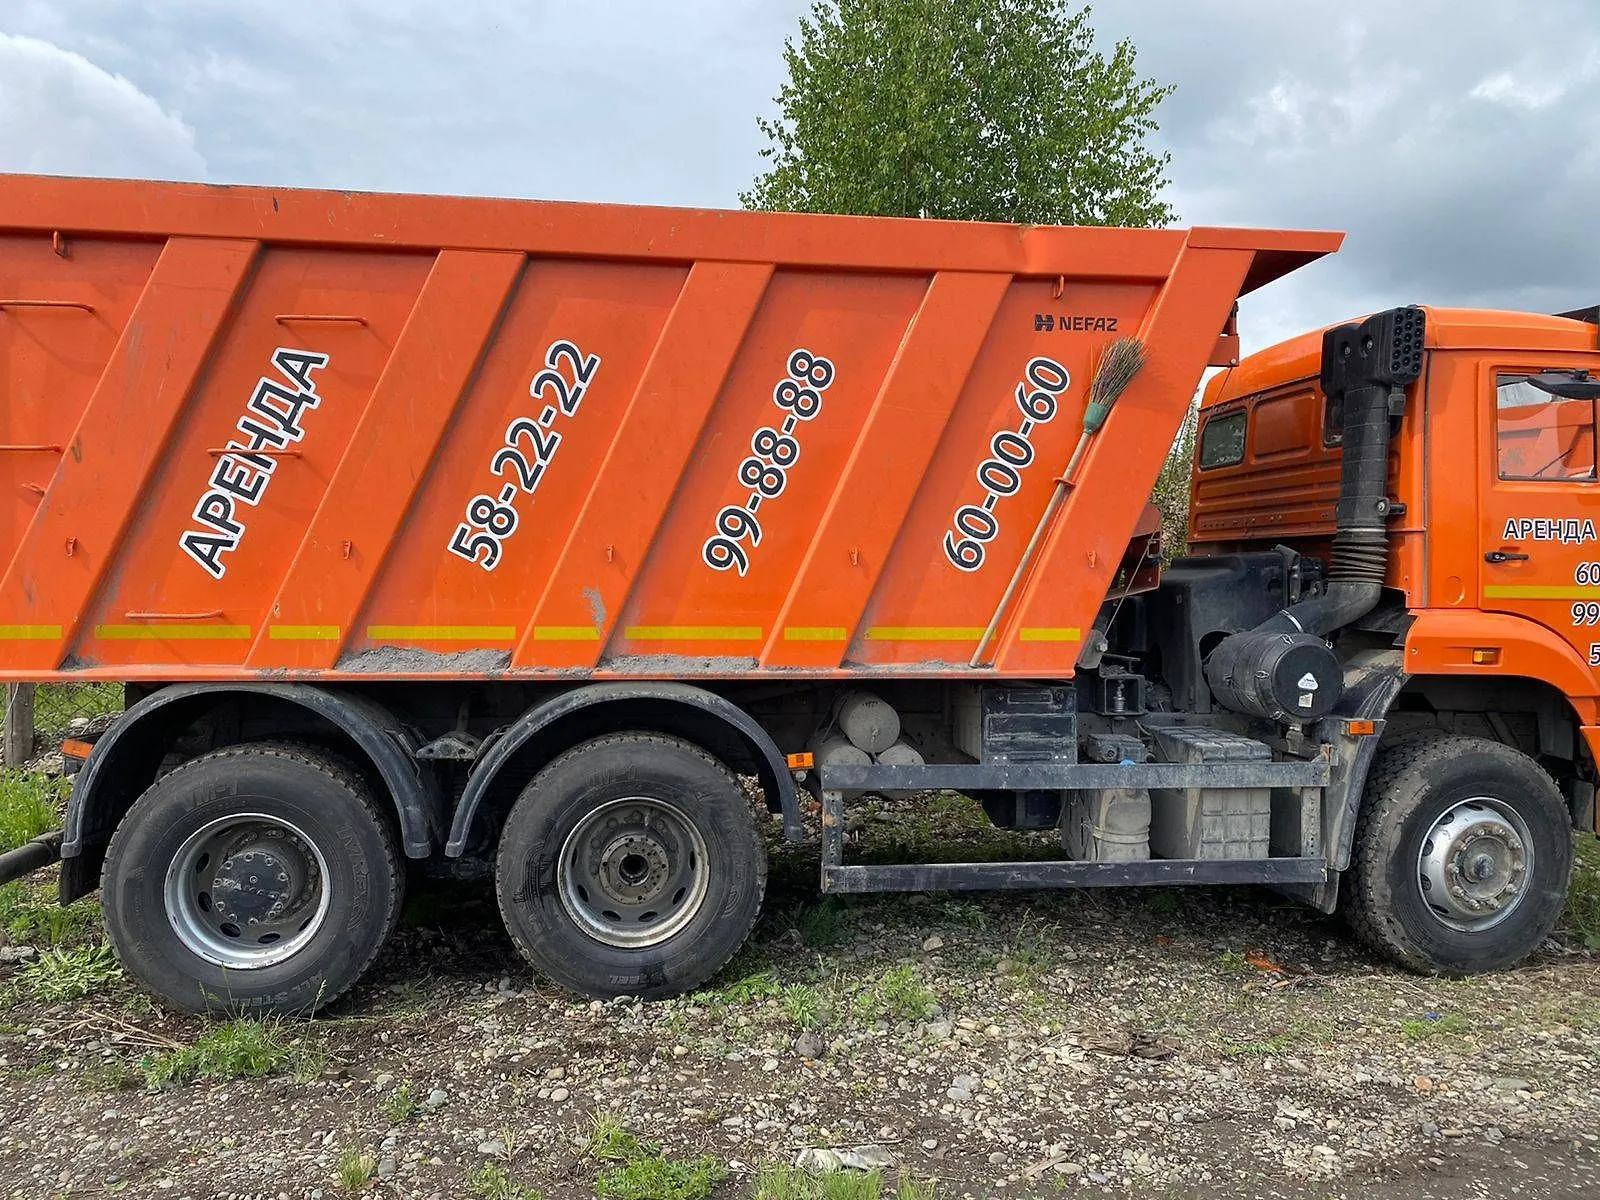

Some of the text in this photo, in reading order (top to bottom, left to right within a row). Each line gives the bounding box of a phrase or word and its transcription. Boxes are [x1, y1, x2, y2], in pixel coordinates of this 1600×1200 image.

[1059, 316, 1118, 332] NEFAZ
[178, 346, 330, 580] АРЕНДА
[447, 339, 601, 571] 58-22-22
[702, 348, 836, 577] 99-88-88
[943, 356, 1070, 573] 60-00-60
[1503, 518, 1597, 544] АРЕНДА
